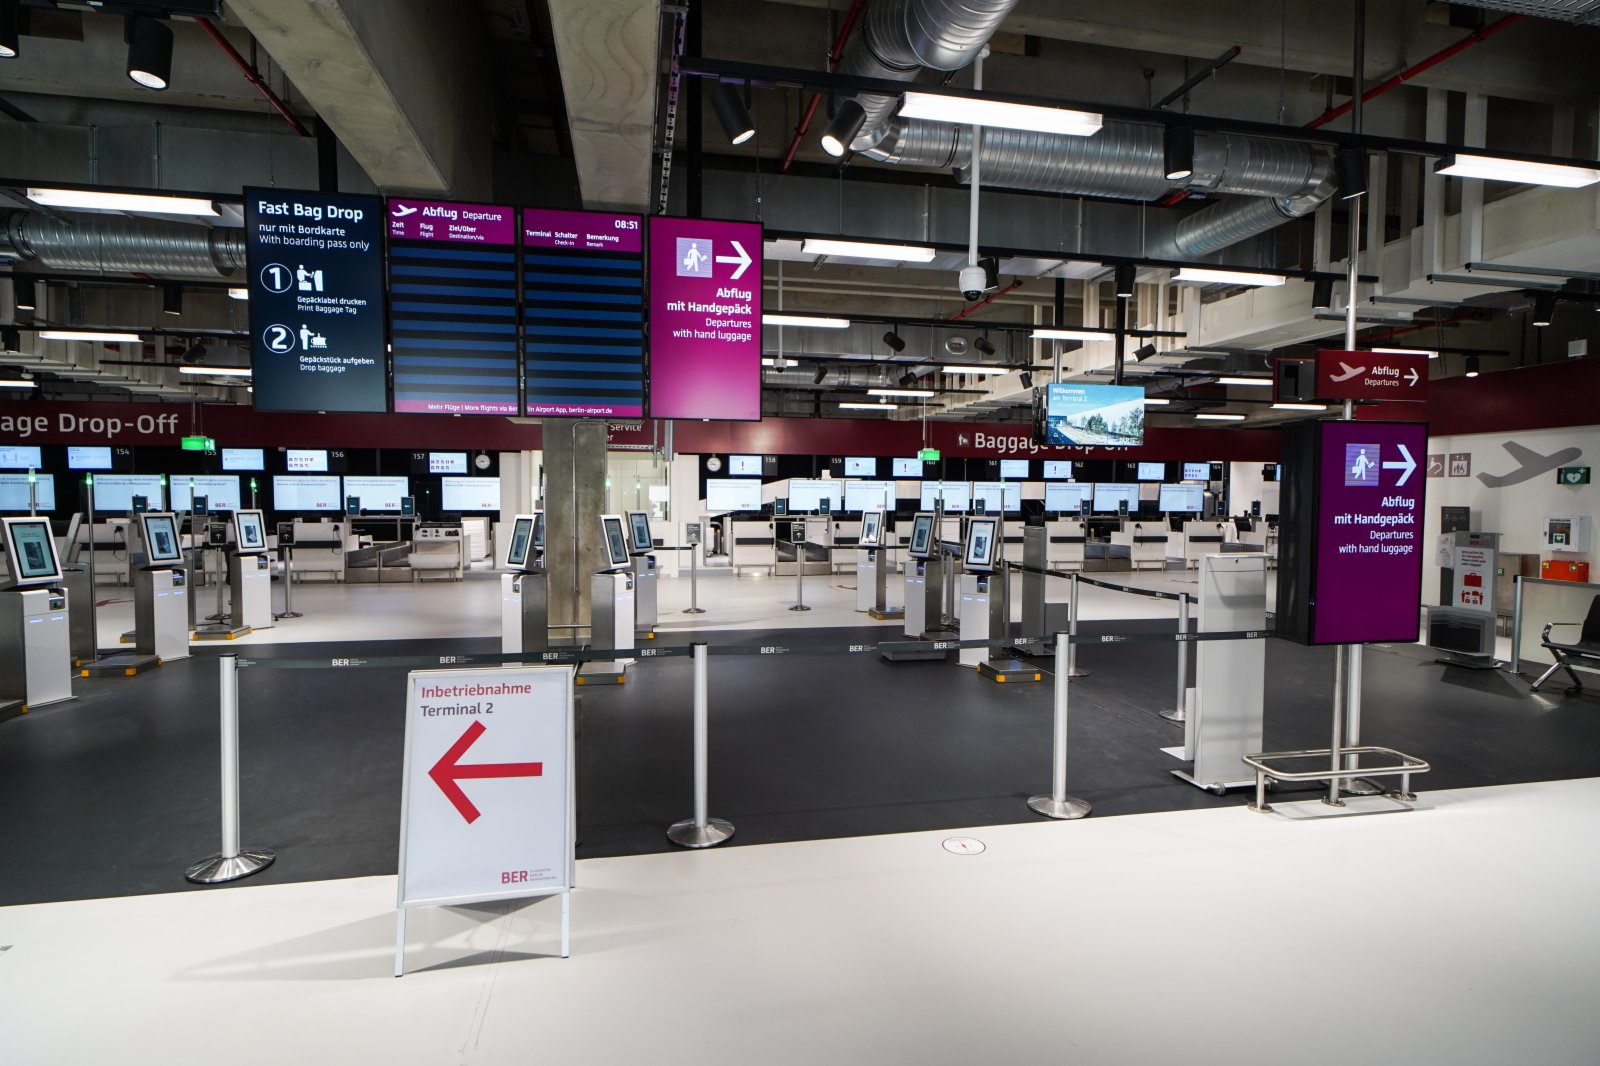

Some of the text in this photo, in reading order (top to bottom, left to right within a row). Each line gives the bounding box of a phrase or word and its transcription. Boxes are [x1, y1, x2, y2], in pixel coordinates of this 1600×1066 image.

[259, 201, 363, 222] Fast Bag Drop
[422, 206, 502, 221] Abflug Departure
[279, 224, 295, 233] mit
[298, 225, 345, 235] Bordkarte
[615, 220, 638, 229] 08:51
[260, 234, 370, 251] With boarding pass only
[586, 234, 619, 242] Bemerkung
[269, 267, 281, 289] 1
[716, 288, 752, 301] Abflug
[297, 296, 338, 306] Gepäcklabel
[316, 306, 344, 314] Baggage
[667, 302, 752, 316] mit Handgepäck
[706, 318, 752, 329] Departures
[272, 328, 287, 349] 2
[673, 329, 751, 342] with hand luggage
[300, 356, 374, 366] Gepäckstück aufgeben
[300, 364, 346, 373] Drop baggage
[1372, 366, 1400, 378] Abflug
[1364, 378, 1399, 386] Departures
[1, 413, 178, 438] age Drop-Off
[1381, 496, 1415, 509] Abflug
[1334, 513, 1414, 526] mit Handgepäck
[1370, 530, 1414, 541] Departures
[1339, 543, 1413, 555] with hand luggage
[641, 648, 657, 656] BER
[332, 658, 349, 666] BER
[421, 683, 532, 698] Inbetriebnahme
[421, 702, 493, 717] Terminal 2
[502, 870, 528, 884] BER
